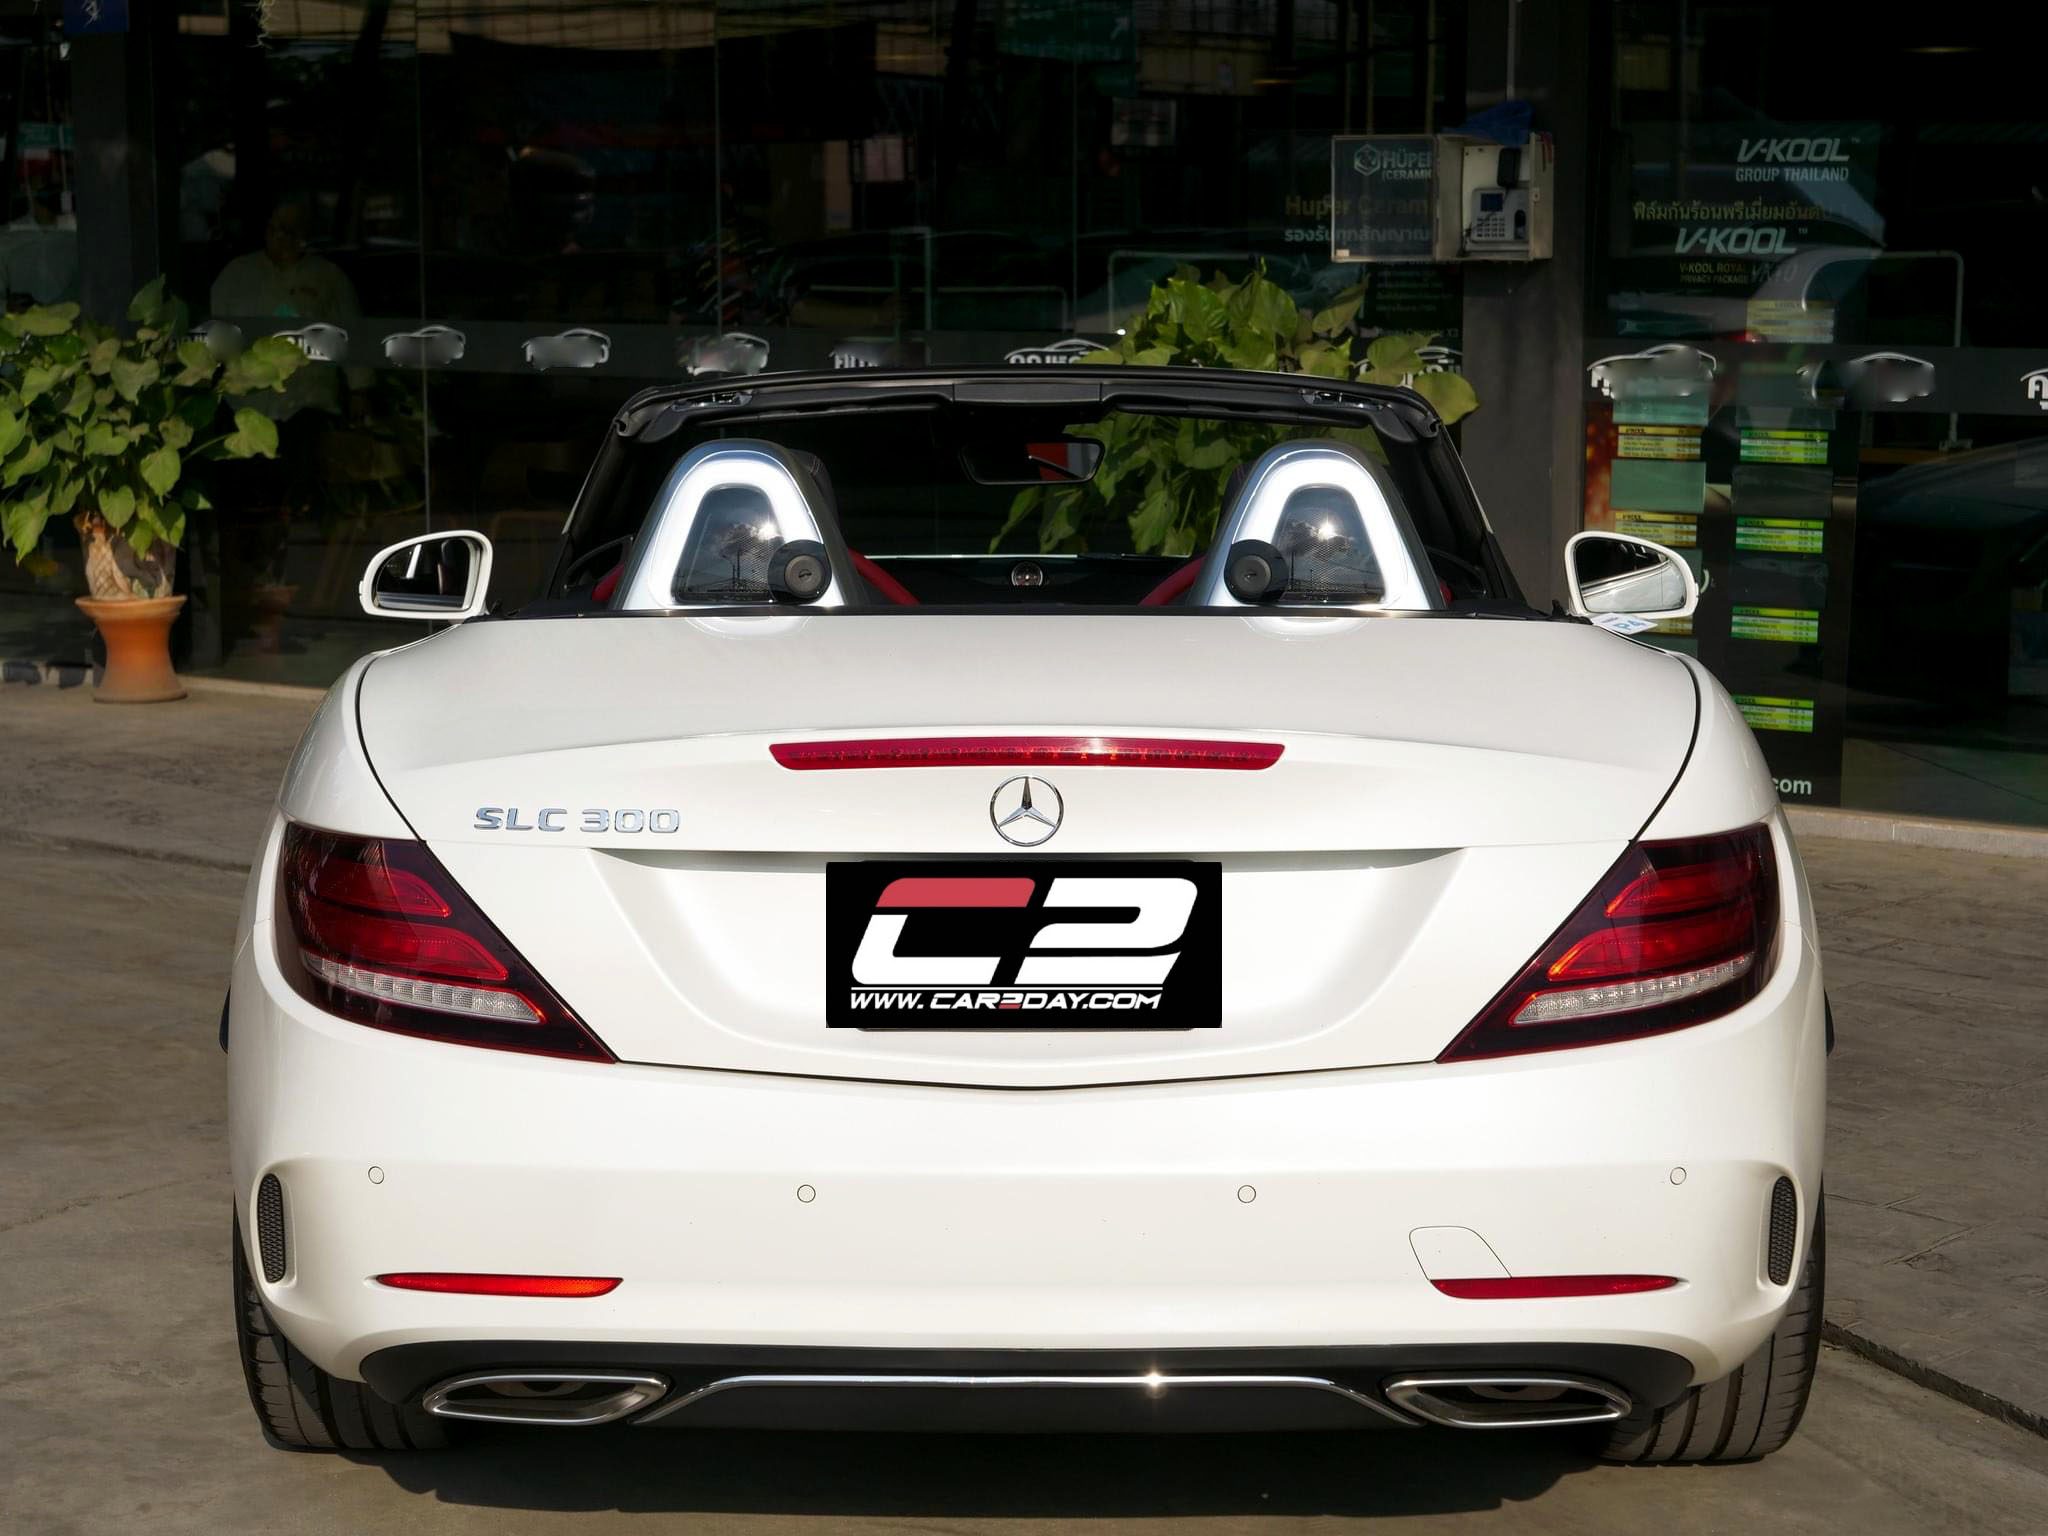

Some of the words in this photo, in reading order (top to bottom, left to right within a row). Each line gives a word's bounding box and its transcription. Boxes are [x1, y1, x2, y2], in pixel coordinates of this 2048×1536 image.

[1736, 137, 1851, 164] V-KOOL
[1735, 166, 1780, 183] GROUP
[1783, 166, 1849, 183] THAILAND
[1674, 227, 1798, 254] V-KOOL
[1679, 261, 1714, 273] V-KOOL
[474, 807, 568, 832] SLC
[579, 808, 680, 834] 300
